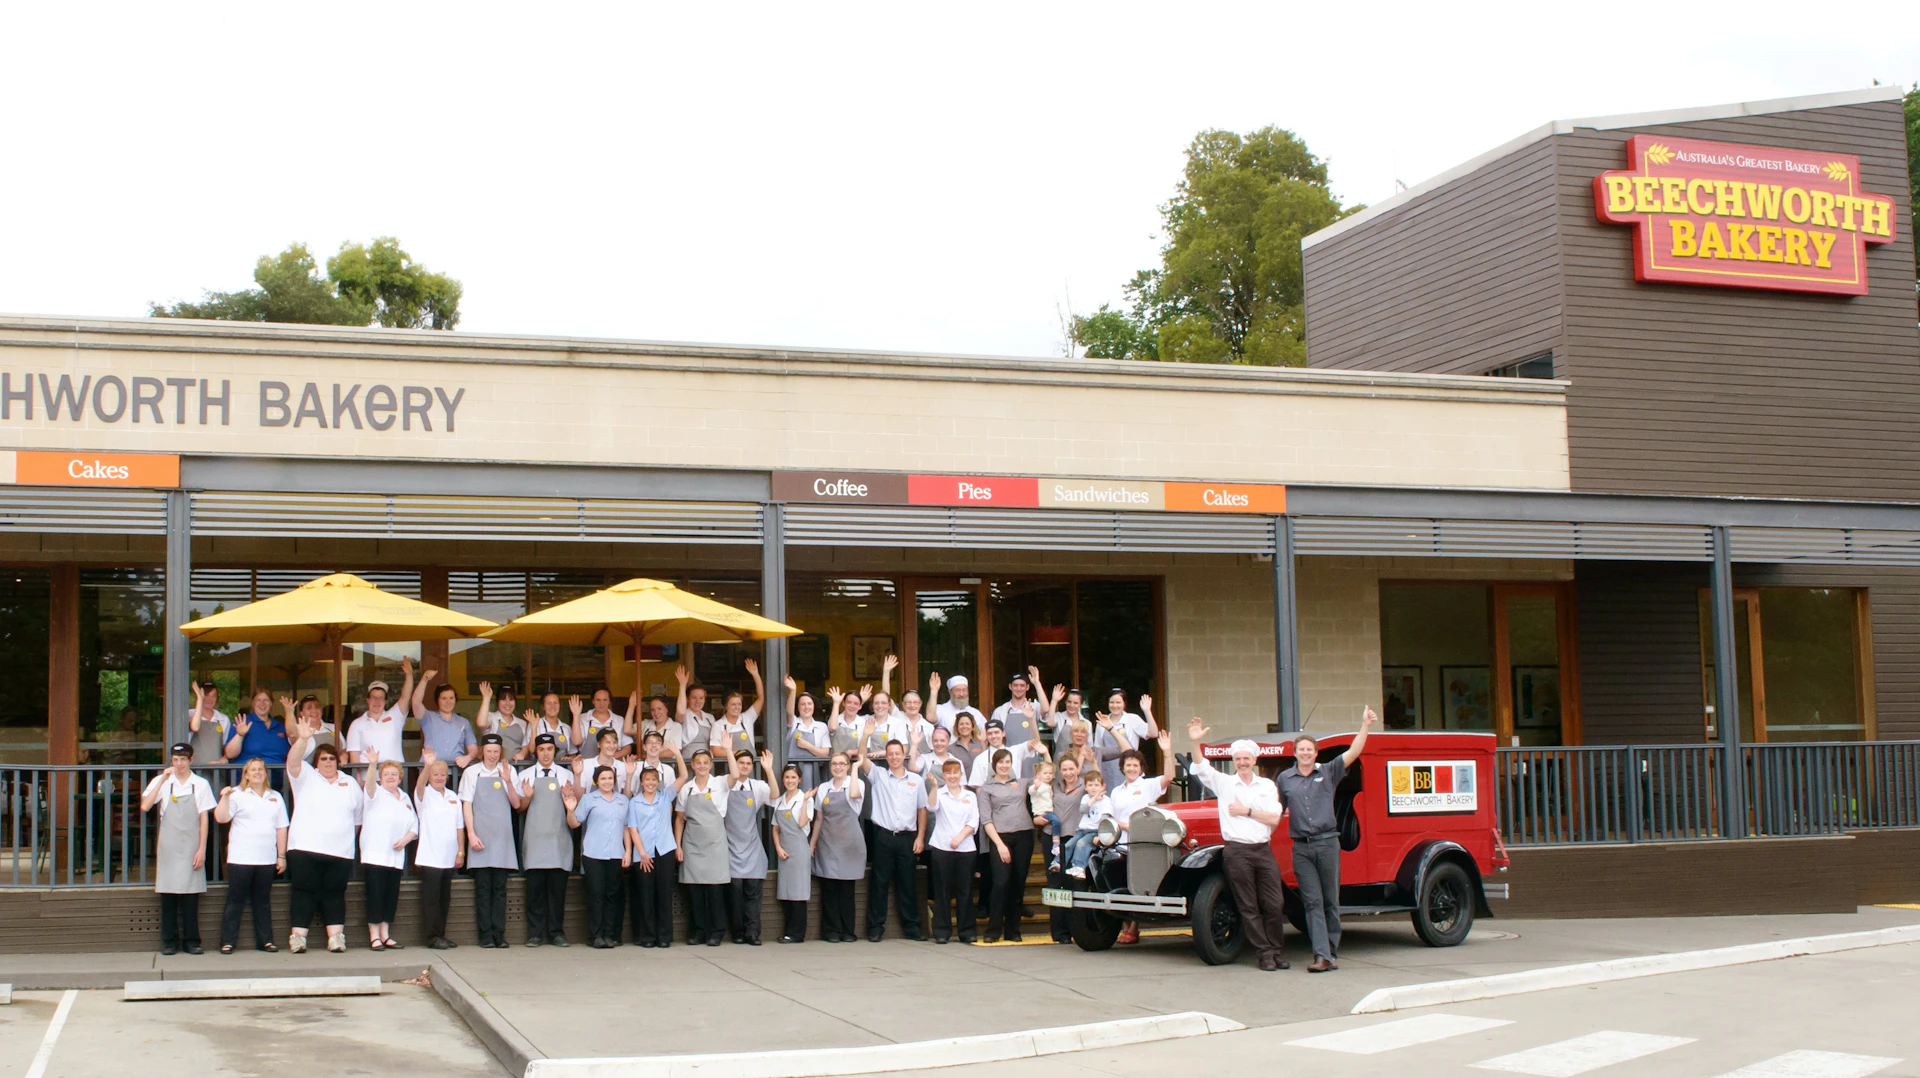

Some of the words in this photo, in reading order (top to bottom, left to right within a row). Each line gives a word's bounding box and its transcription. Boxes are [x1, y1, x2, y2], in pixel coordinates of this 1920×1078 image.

[1675, 150, 1735, 166] AUSTRALIA'S
[1736, 155, 1783, 171] GREATEST
[1784, 159, 1821, 175] BAKERY
[1604, 175, 1891, 237] BEECHWORTH
[1668, 219, 1836, 269] BAKERY
[1, 372, 230, 426] HWORTH
[67, 459, 129, 480] Cakes
[813, 478, 868, 497] Coffee
[957, 482, 992, 500] Pies
[1053, 484, 1150, 504] Sandwiches
[1203, 489, 1250, 507] Cakes
[1257, 746, 1285, 755] AKERY
[1414, 771, 1432, 790] BB
[1391, 794, 1442, 806] BEECHWORTH
[1446, 794, 1475, 805] BAKERY
